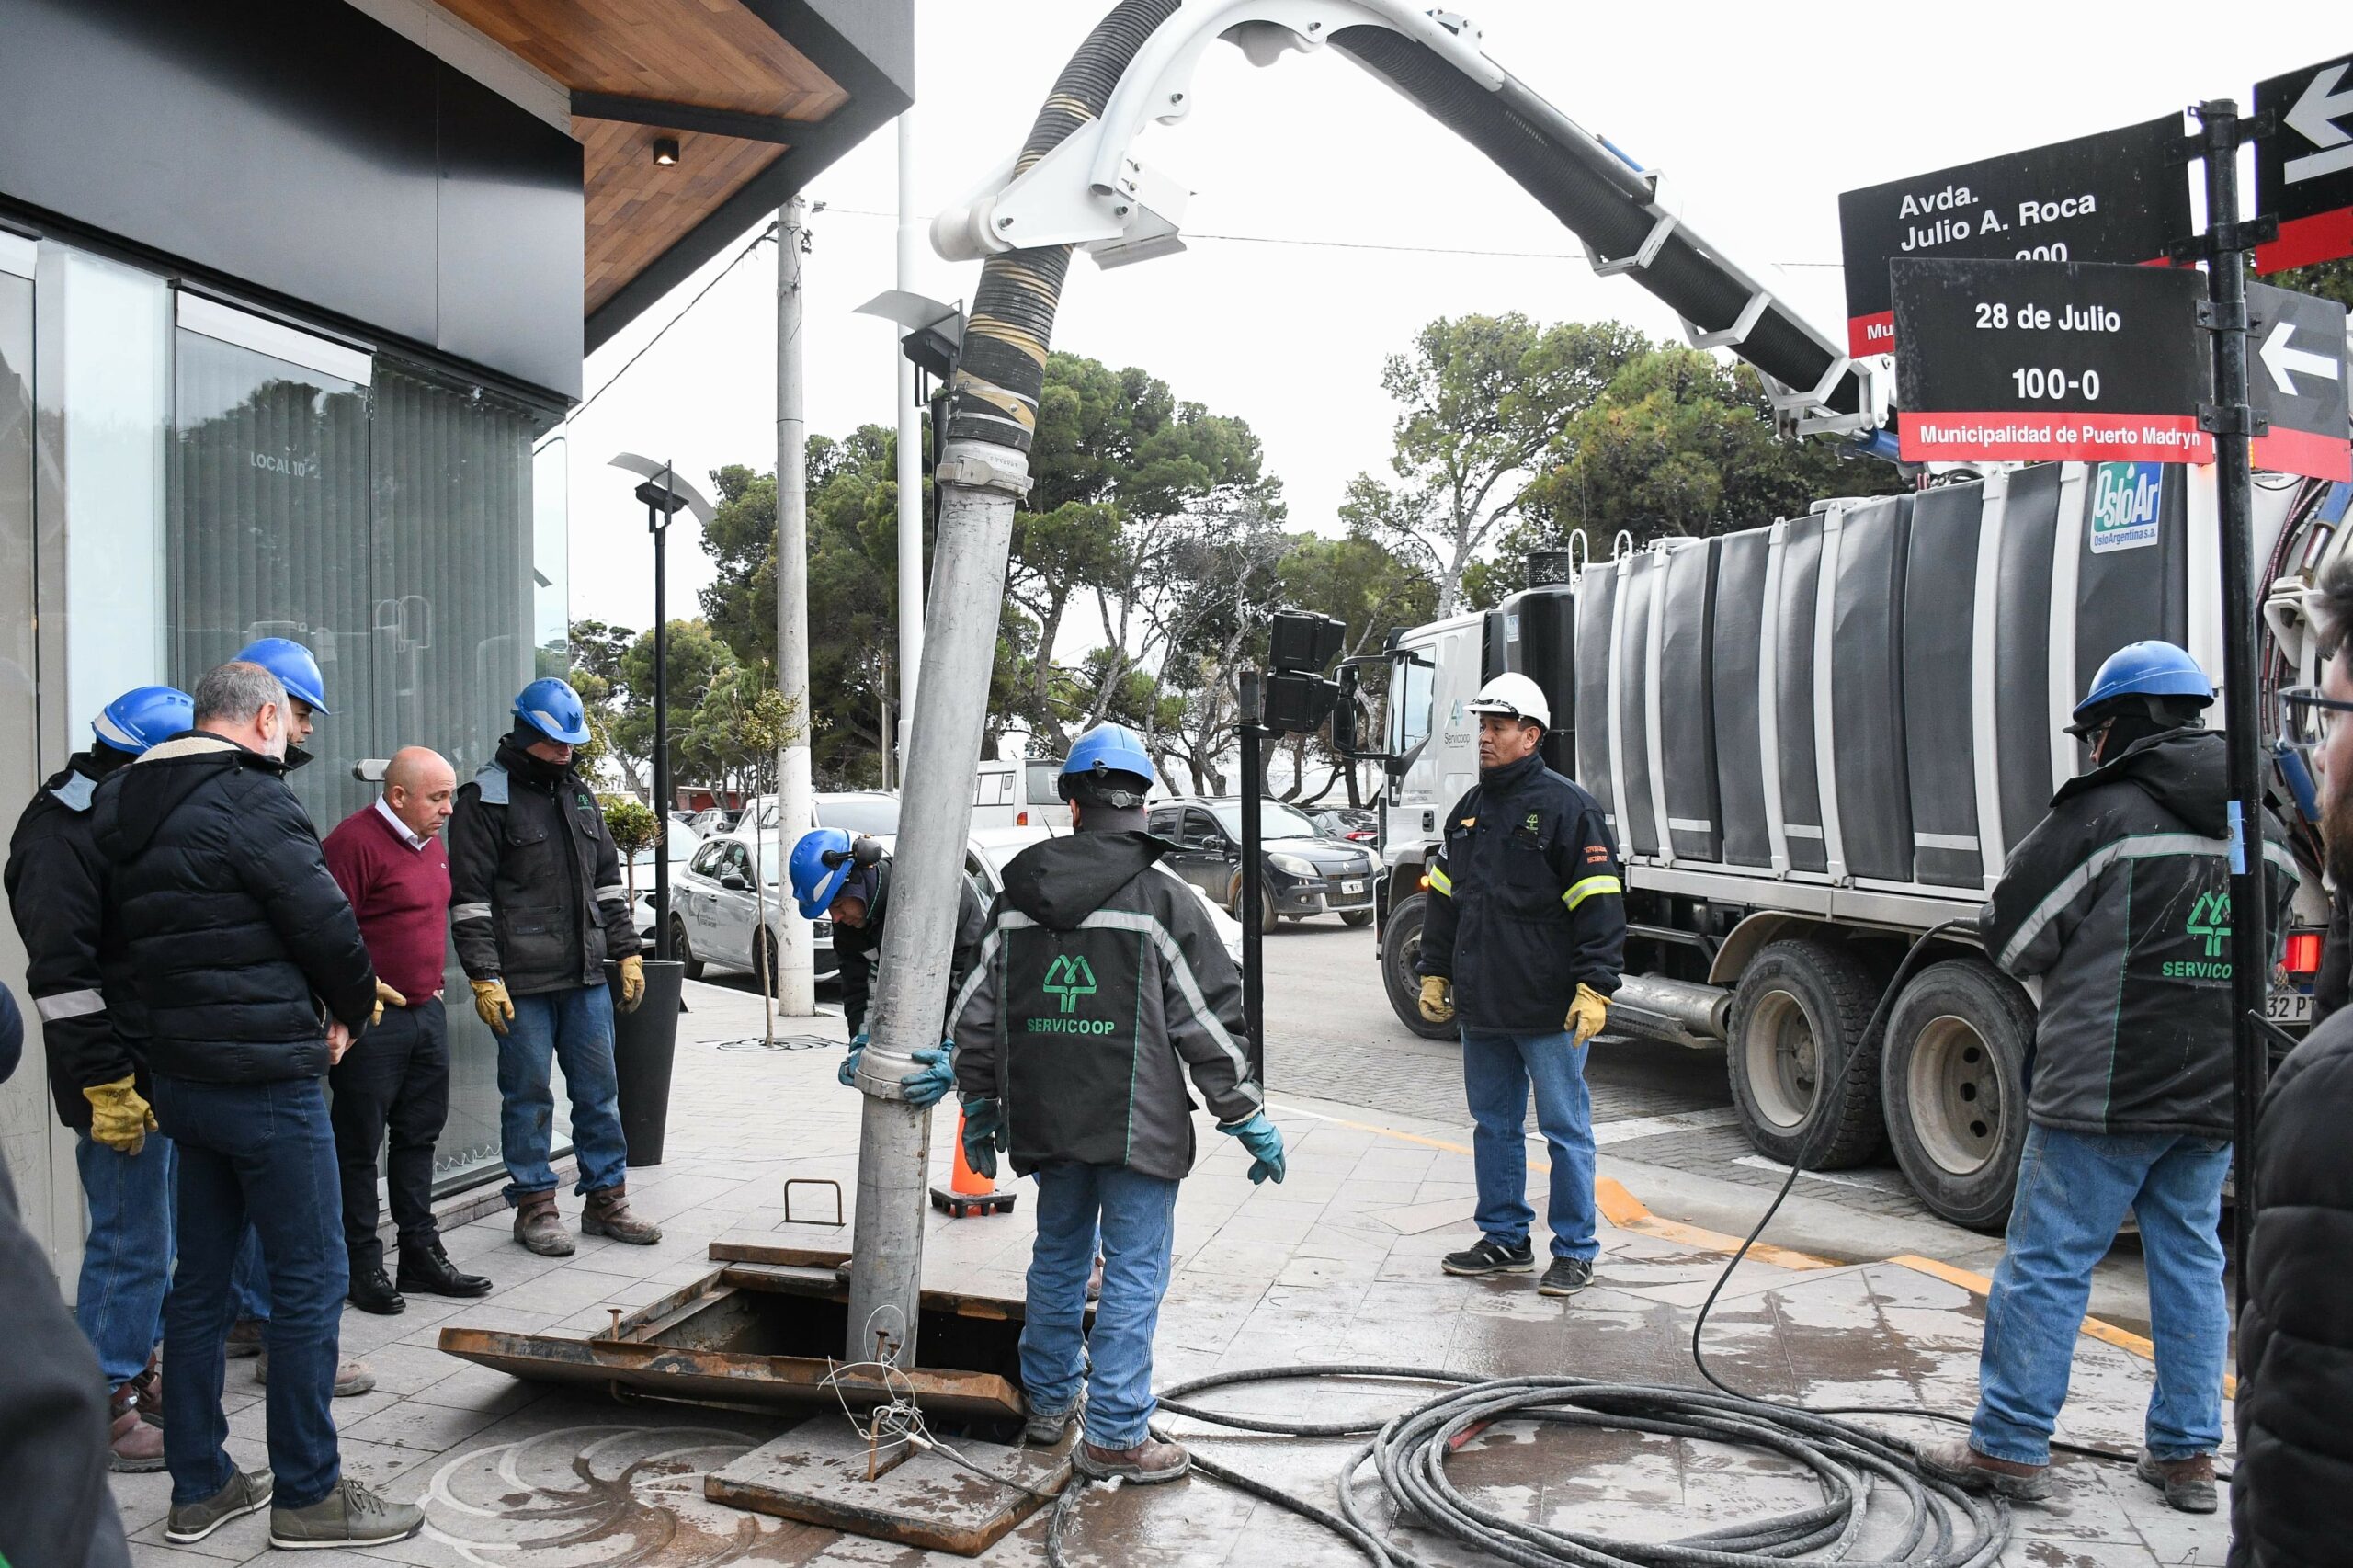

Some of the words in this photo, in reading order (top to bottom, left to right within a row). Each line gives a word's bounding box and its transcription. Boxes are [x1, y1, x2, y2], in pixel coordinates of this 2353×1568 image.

[1899, 185, 1979, 220] Avda.
[1900, 219, 1970, 252] Julio
[1979, 210, 2009, 235] A.
[2018, 194, 2097, 227] Roca
[1975, 302, 2009, 329] 28
[2017, 303, 2052, 330] de
[2058, 304, 2121, 332] Julio
[1867, 323, 1894, 340] Mu
[2012, 368, 2100, 401] 100-0
[1920, 426, 2051, 447] Municipalidad
[2055, 426, 2077, 444] de
[2083, 426, 2138, 445] Puerto
[2143, 426, 2200, 449] Madryn
[250, 451, 291, 474] LOCAL
[1027, 1018, 1115, 1035] SERVICOOP
